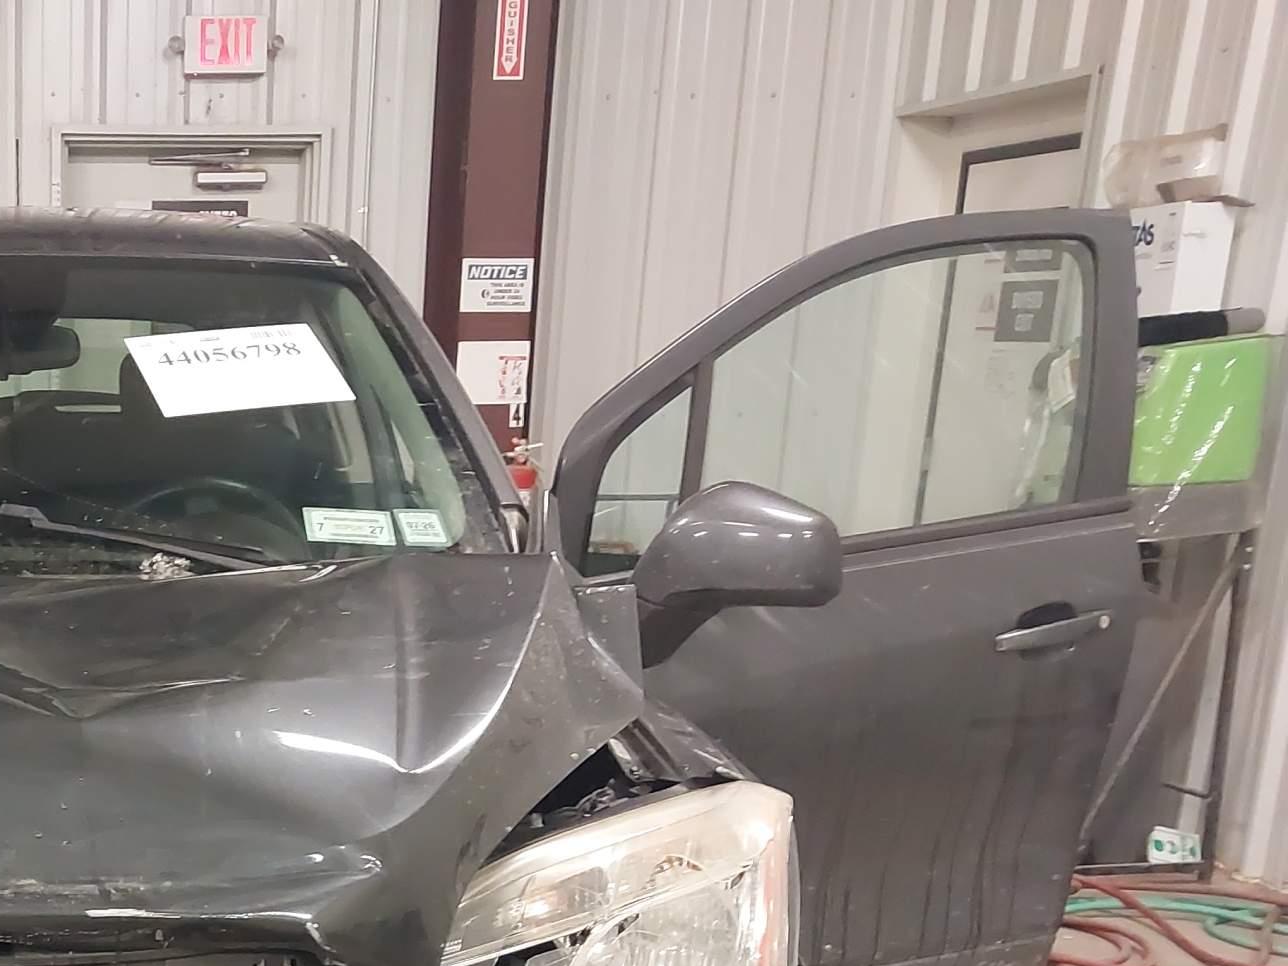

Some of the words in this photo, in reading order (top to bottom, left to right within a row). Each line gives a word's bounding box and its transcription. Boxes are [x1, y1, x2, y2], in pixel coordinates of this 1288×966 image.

[200, 18, 257, 65] EXIT
[469, 265, 526, 279] NOTICE
[158, 342, 302, 366] 44056798
[512, 403, 522, 426] 4
[368, 525, 384, 535] 27
